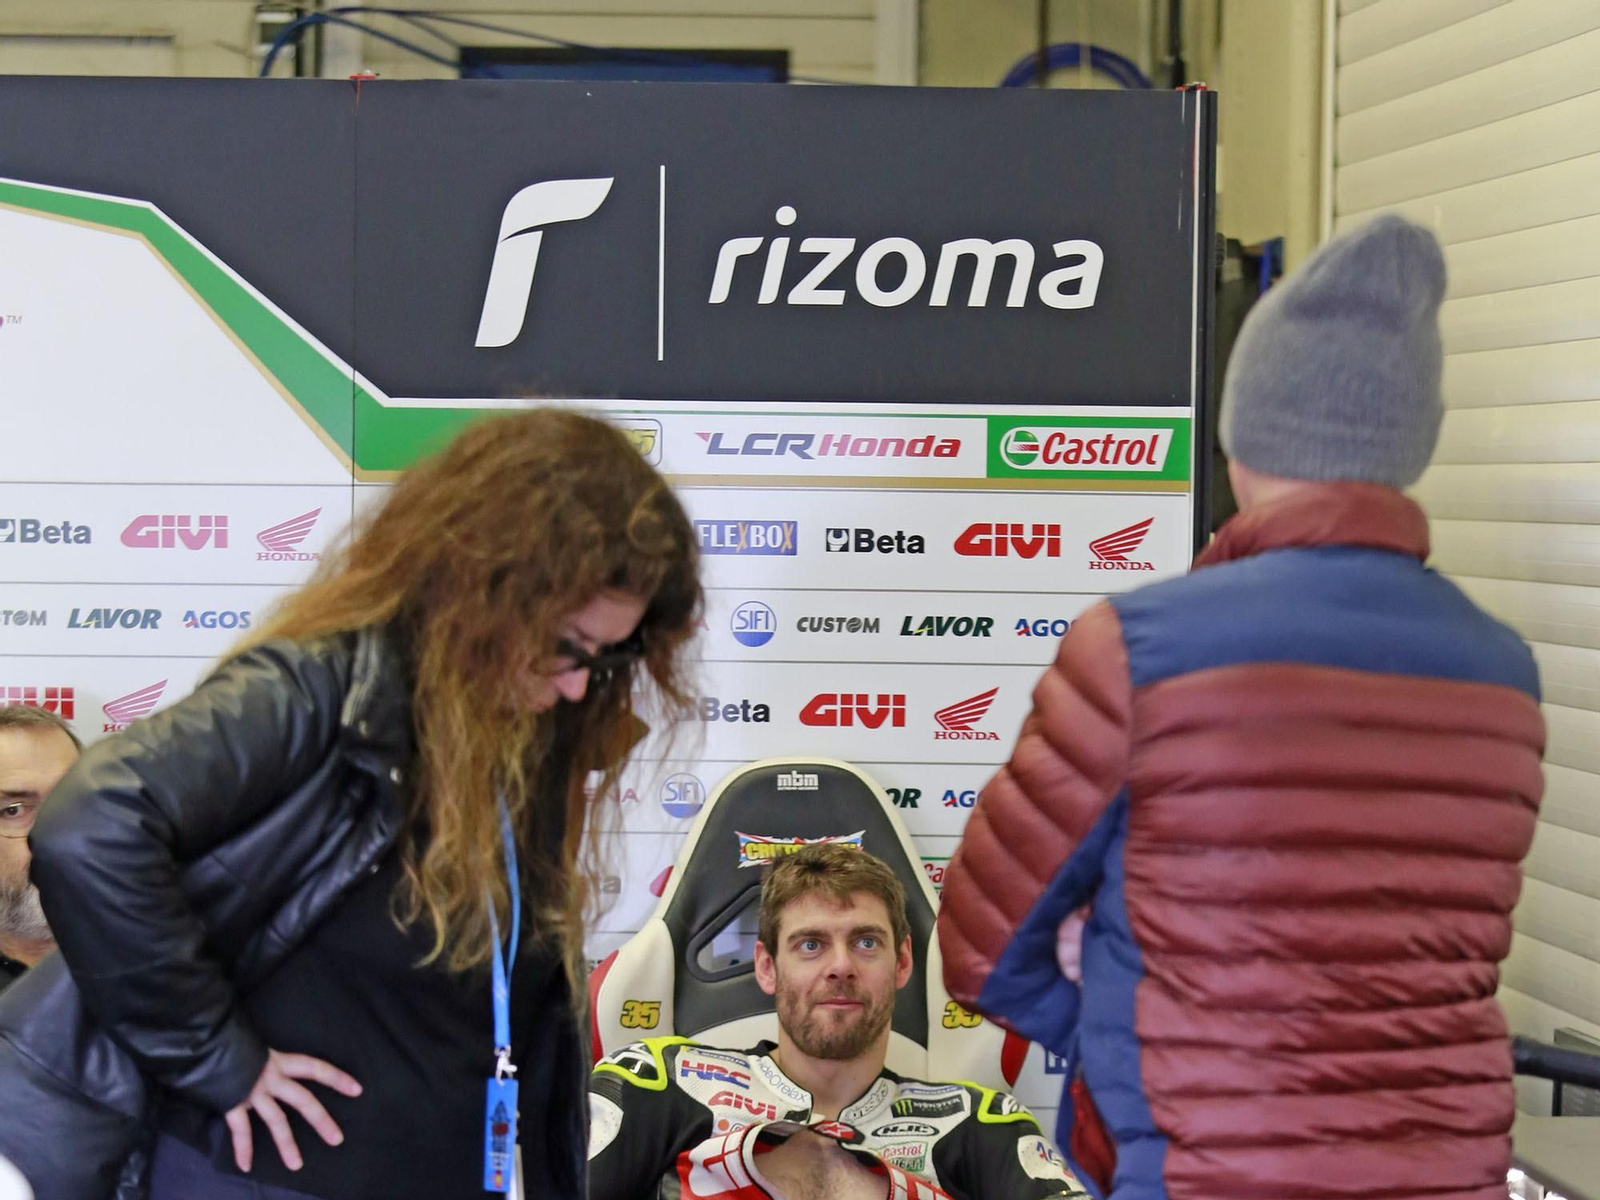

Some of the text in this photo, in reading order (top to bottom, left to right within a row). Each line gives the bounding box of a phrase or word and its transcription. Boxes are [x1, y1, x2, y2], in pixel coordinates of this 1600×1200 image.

[708, 205, 1104, 310] rizoma
[706, 432, 962, 460] LCR Honda
[1042, 432, 1160, 466] Castrol
[20, 519, 92, 544] Beta
[120, 514, 229, 550] GIVI
[698, 522, 794, 553] FLEXBOX
[855, 528, 925, 554] Beta
[954, 523, 1061, 559] GIVI
[256, 552, 323, 562] HONDA
[1089, 561, 1156, 571] HONDA
[0, 610, 47, 626] TOM
[68, 608, 162, 629] LAVOR
[182, 610, 251, 629] AGOS
[735, 610, 769, 630] SIFI
[797, 617, 880, 633] CUSTOM
[900, 616, 994, 637] LAVOR
[1015, 618, 1075, 637] AGO
[702, 697, 770, 723] Beta
[800, 693, 906, 729] GIVI
[934, 731, 1000, 740] HONDA
[777, 771, 819, 786] mbm
[664, 782, 699, 801] SIFI
[620, 1000, 661, 1029] 35
[681, 1059, 752, 1090] HRC
[708, 1090, 777, 1121] GIVI
[883, 1144, 923, 1158] Castrol
